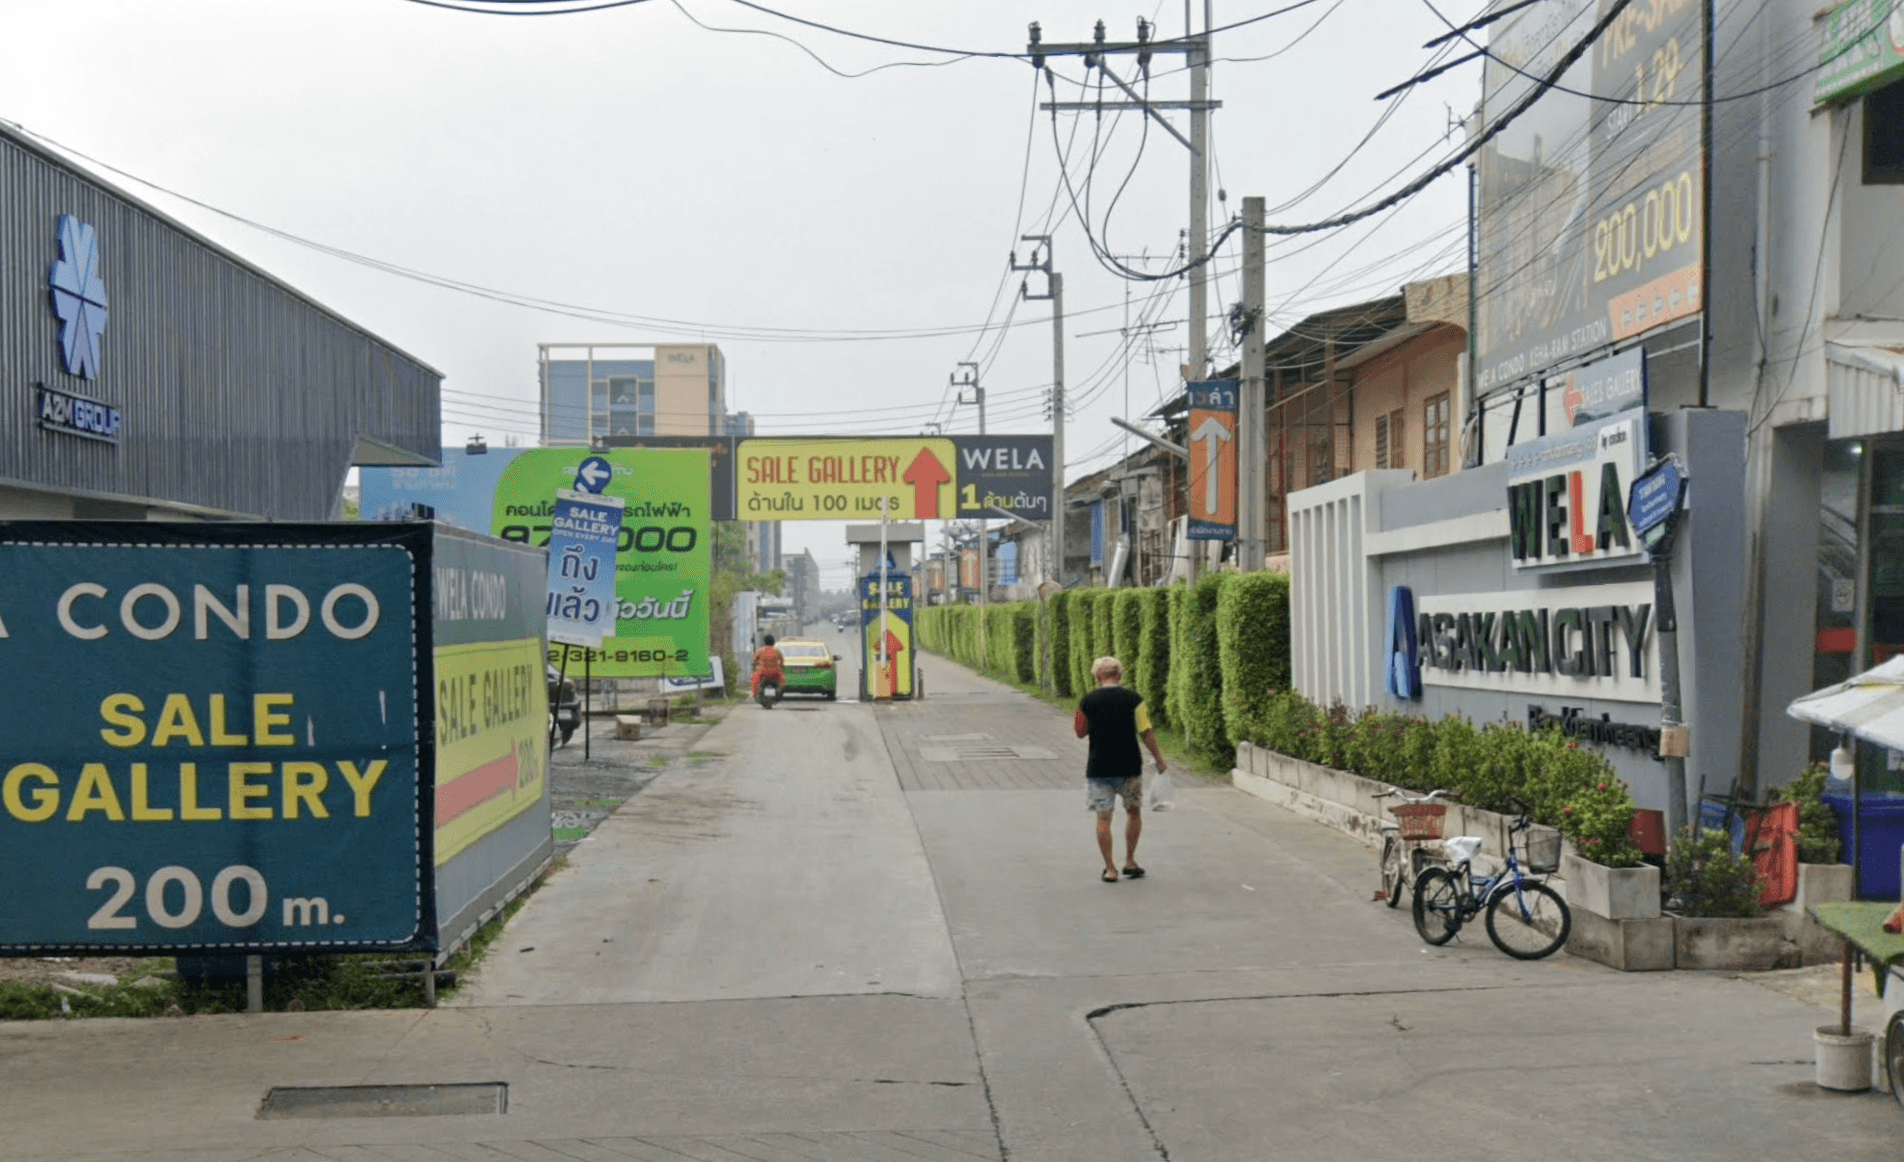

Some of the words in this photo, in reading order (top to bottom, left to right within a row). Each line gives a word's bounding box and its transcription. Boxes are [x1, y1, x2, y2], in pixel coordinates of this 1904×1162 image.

[1594, 171, 1692, 282] 200,000
[1571, 316, 1608, 352] STATION
[74, 400, 120, 435] GROUP
[747, 455, 799, 484] SALE
[808, 455, 901, 484] GALLERY
[962, 448, 1045, 470] WELA
[570, 506, 608, 523] SALE
[813, 494, 848, 512] 100
[961, 483, 981, 510] 1
[1507, 462, 1631, 560] WELA
[554, 516, 619, 536] GALLERY
[560, 543, 599, 582] ถึง
[57, 582, 380, 640] CONDO
[546, 585, 600, 622] แล้ว
[100, 693, 294, 747] SALE
[440, 673, 478, 747] SALE
[483, 663, 534, 730] GALLERY
[2, 760, 388, 822] GALLERY
[86, 865, 268, 929] 200
[282, 897, 345, 927] m.
